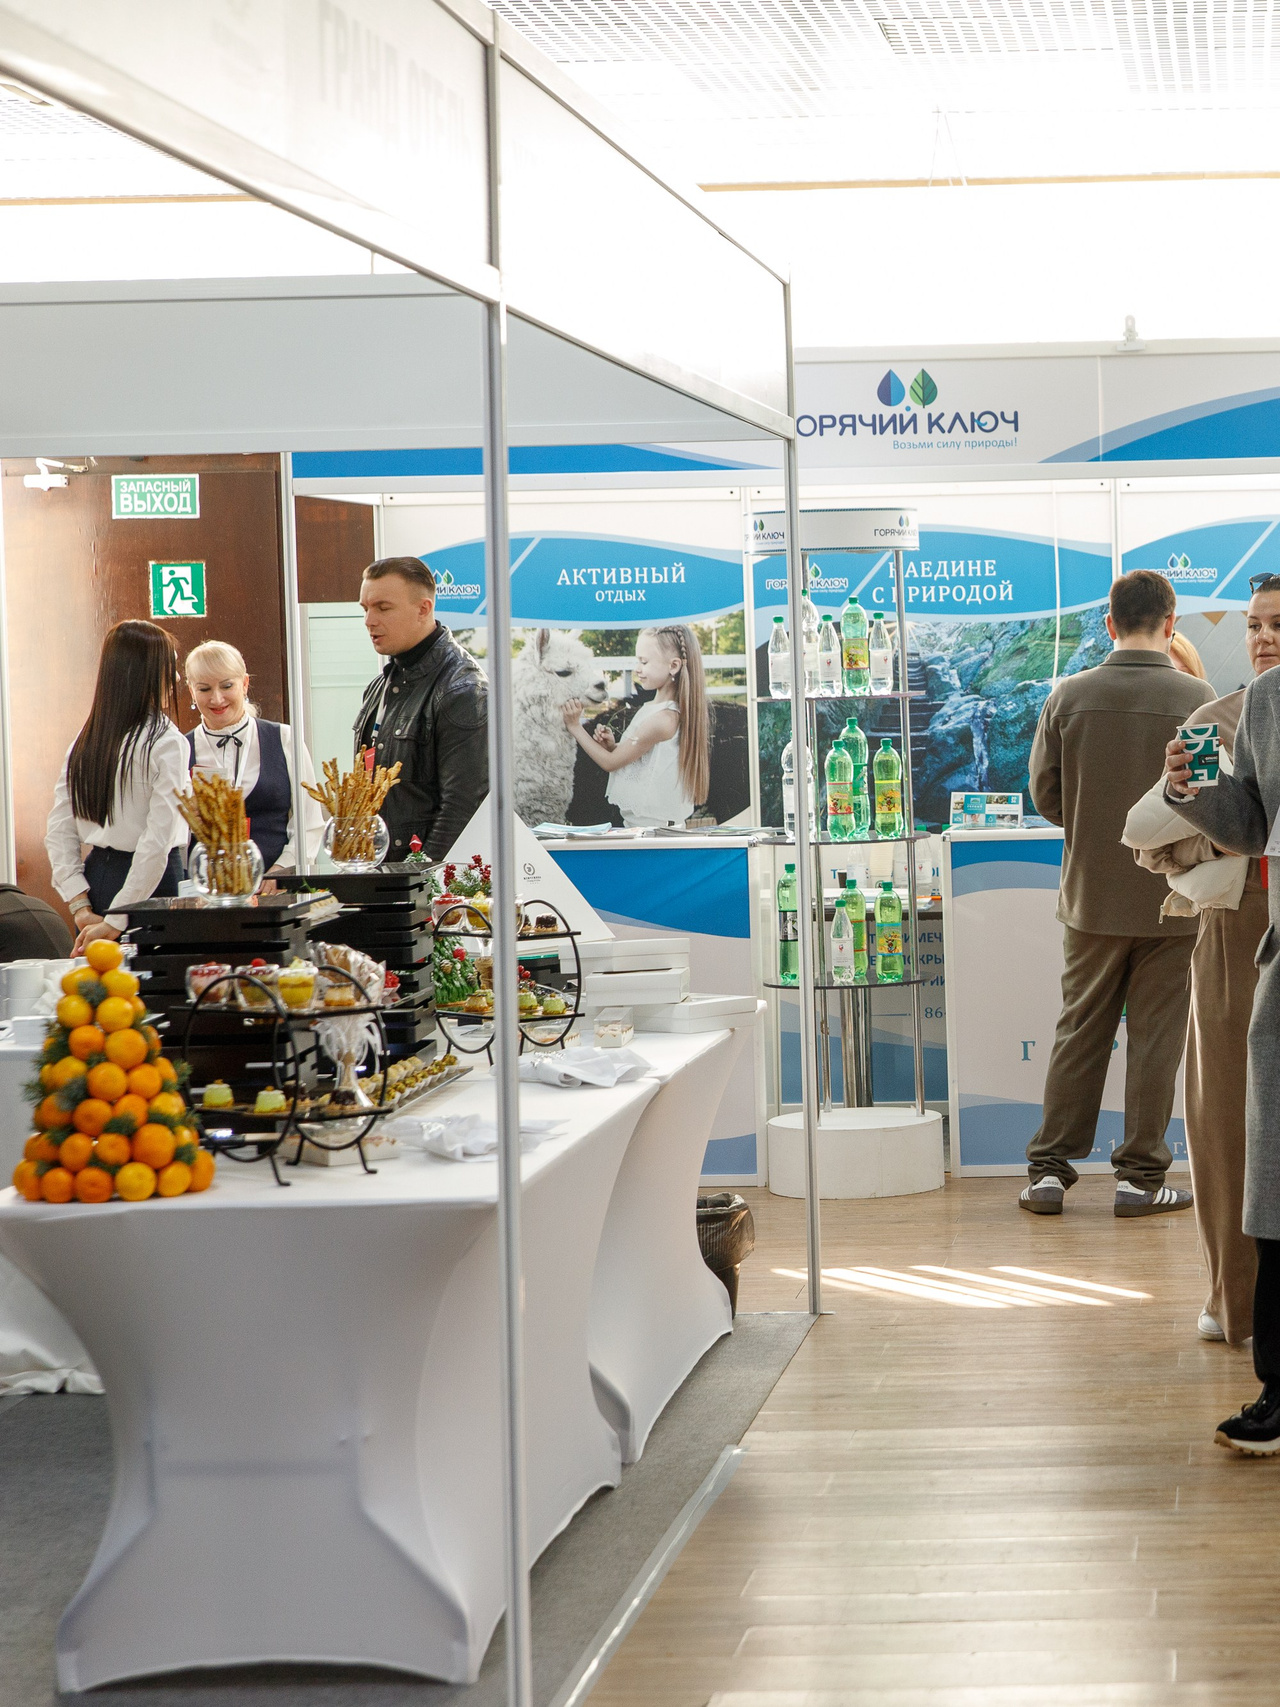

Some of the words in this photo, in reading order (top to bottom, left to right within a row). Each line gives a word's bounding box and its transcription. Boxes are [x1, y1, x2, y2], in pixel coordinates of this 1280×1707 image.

[796, 405, 918, 437] ОРЯЧИЙ
[928, 410, 1019, 434] КЛЮЧ
[892, 439, 934, 450] Возьми
[936, 440, 962, 451] силу
[964, 437, 1018, 450] природы!
[120, 479, 191, 493] ЗАПАСНЫЙ
[120, 493, 192, 514] ВЫХОД
[556, 562, 686, 586] АКТИВНЫЙ
[1185, 567, 1217, 578] КЛЮЧ
[448, 585, 480, 594] КЛЮЧ
[818, 578, 848, 588] КЛЮЧ
[595, 589, 647, 604] ОТДЫХ
[872, 587, 885, 603] С
